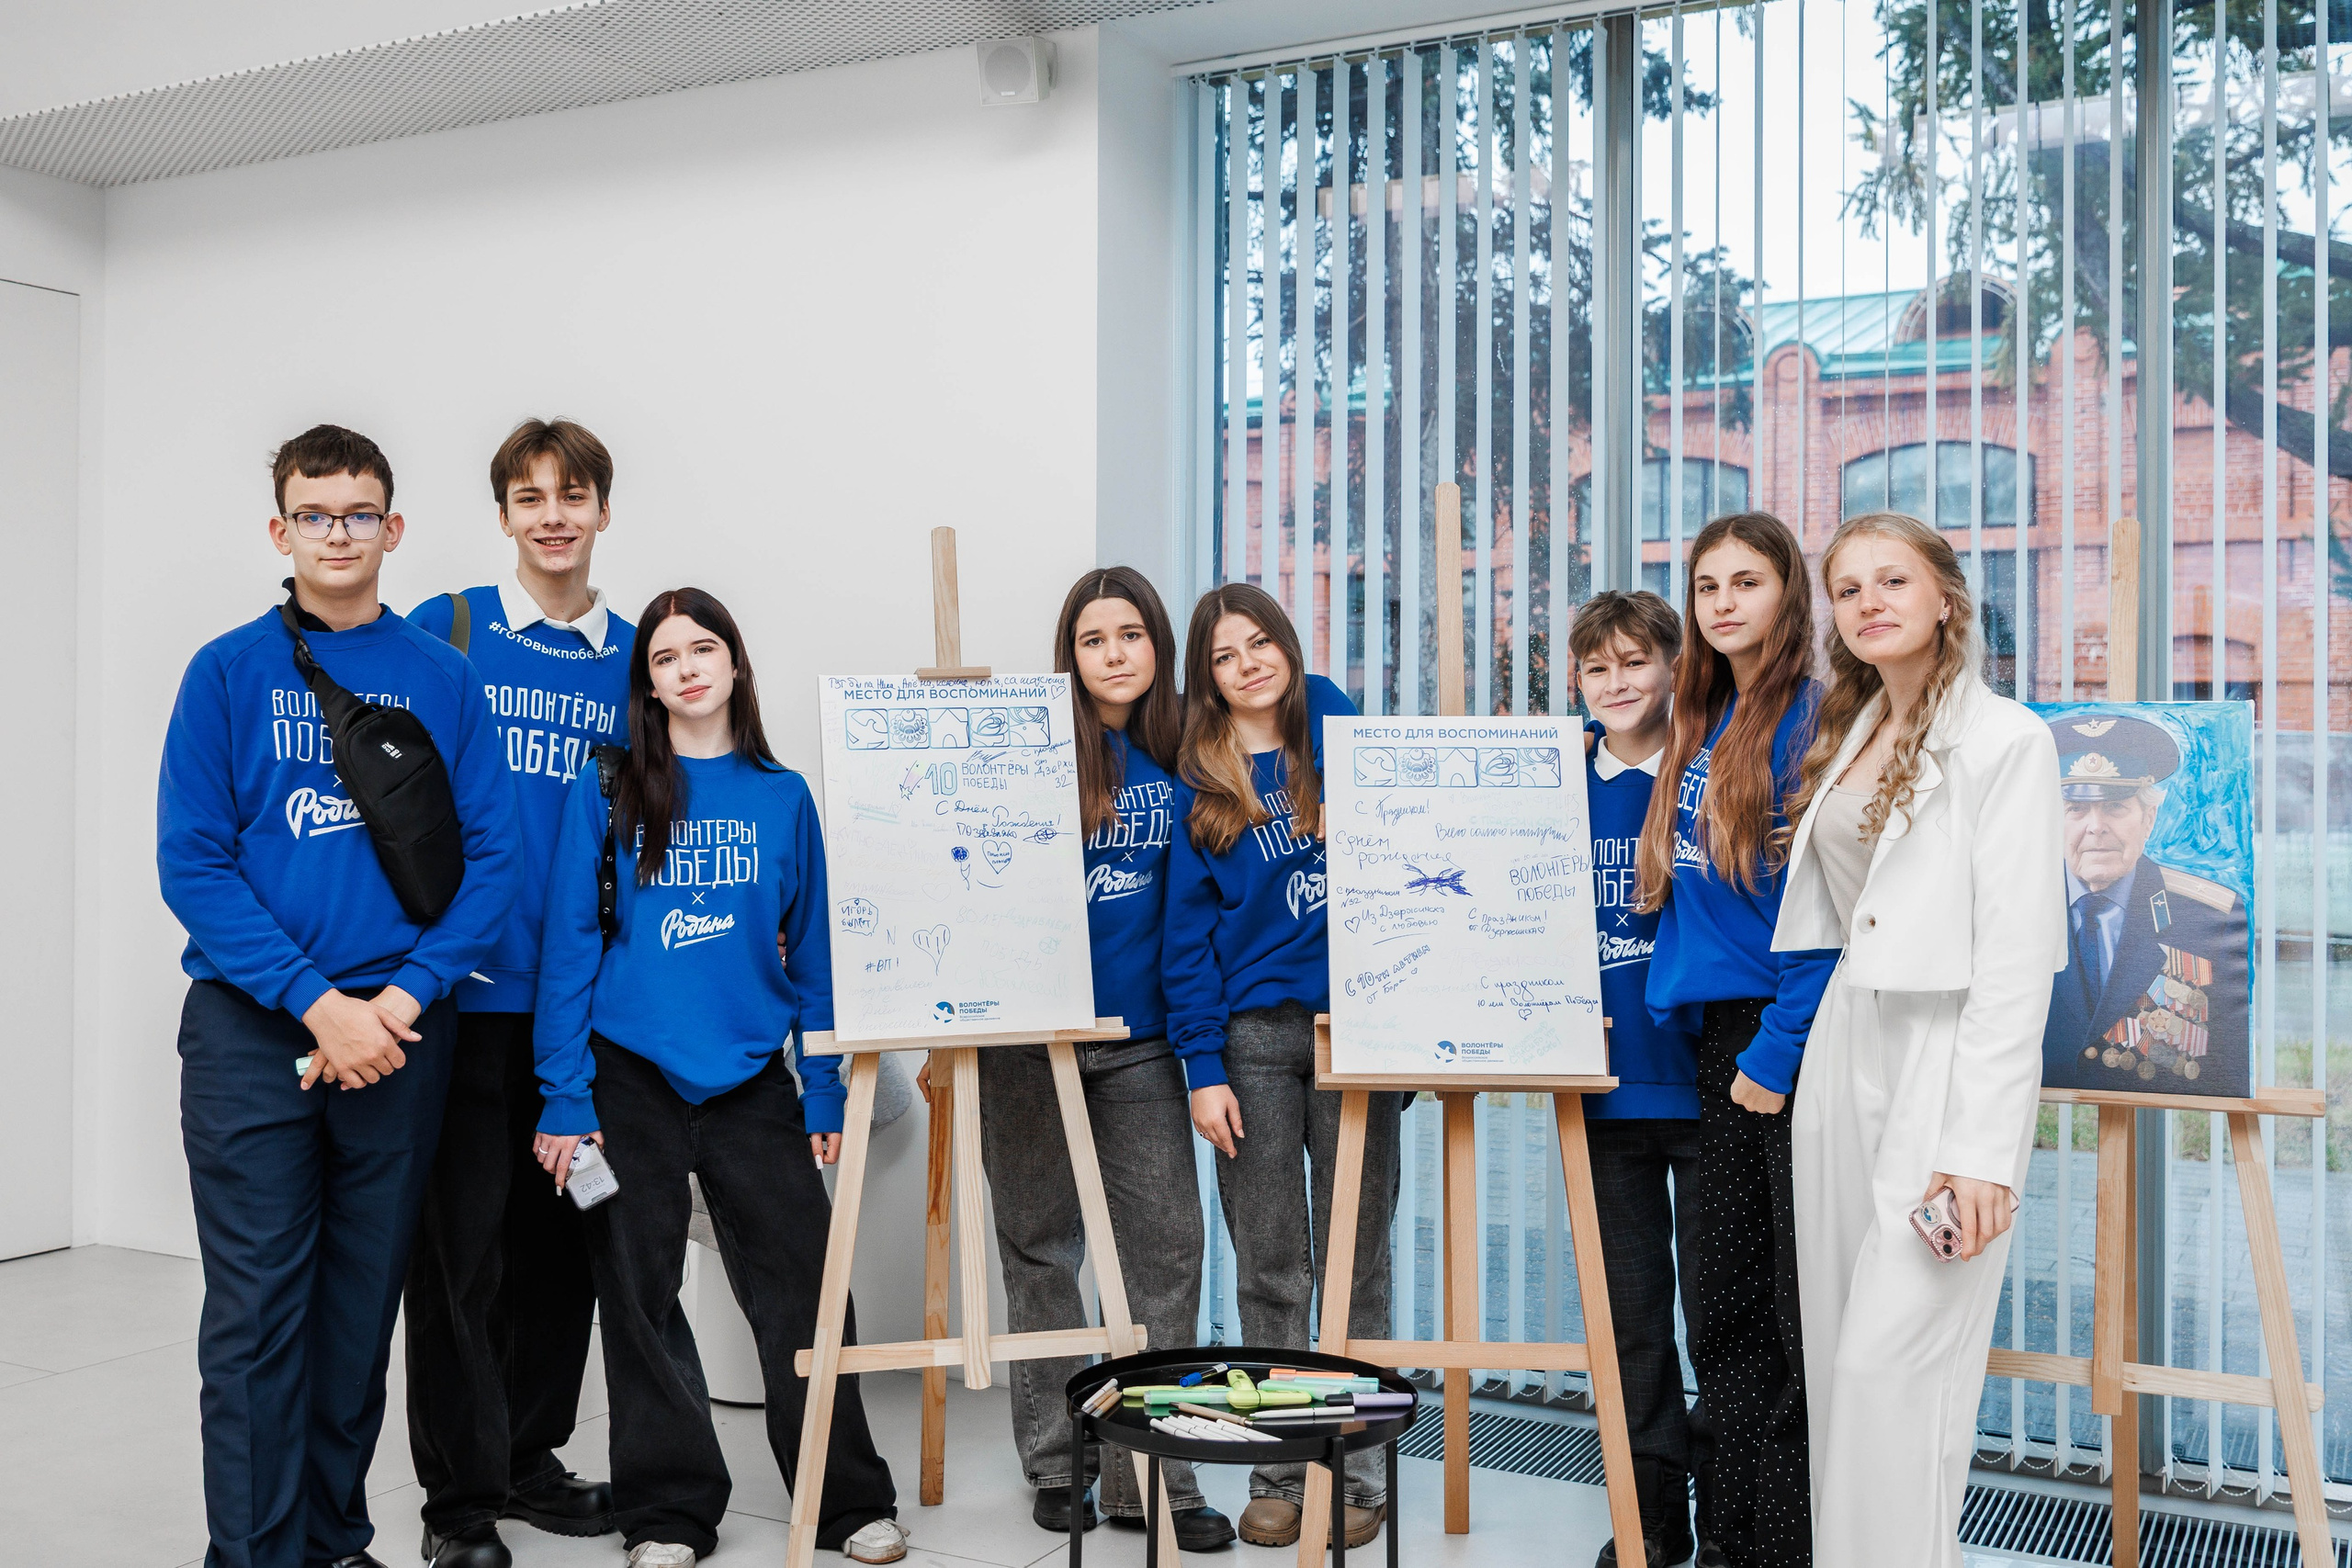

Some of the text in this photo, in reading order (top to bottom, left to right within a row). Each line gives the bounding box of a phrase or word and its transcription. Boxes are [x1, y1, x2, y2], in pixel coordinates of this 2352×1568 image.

[844, 686, 1047, 701] МЕСТО ДЛЯ ВОСПОМИНАНИЙ
[1353, 727, 1558, 740] МЕСТО ДЛЯ ВОСПОМИНАНИЙ
[963, 777, 1008, 790] ПОБЕДЫ
[935, 799, 949, 815] С
[841, 906, 873, 916] ИГОРЬ
[1362, 909, 1376, 924] Из
[1468, 908, 1476, 919] С
[661, 908, 735, 951] Родина
[1392, 917, 1438, 930] любовью
[1345, 978, 1356, 997] С
[1481, 976, 1565, 1001] С праздником
[1477, 999, 1485, 1008] 10
[580, 1176, 605, 1193] 13:42
